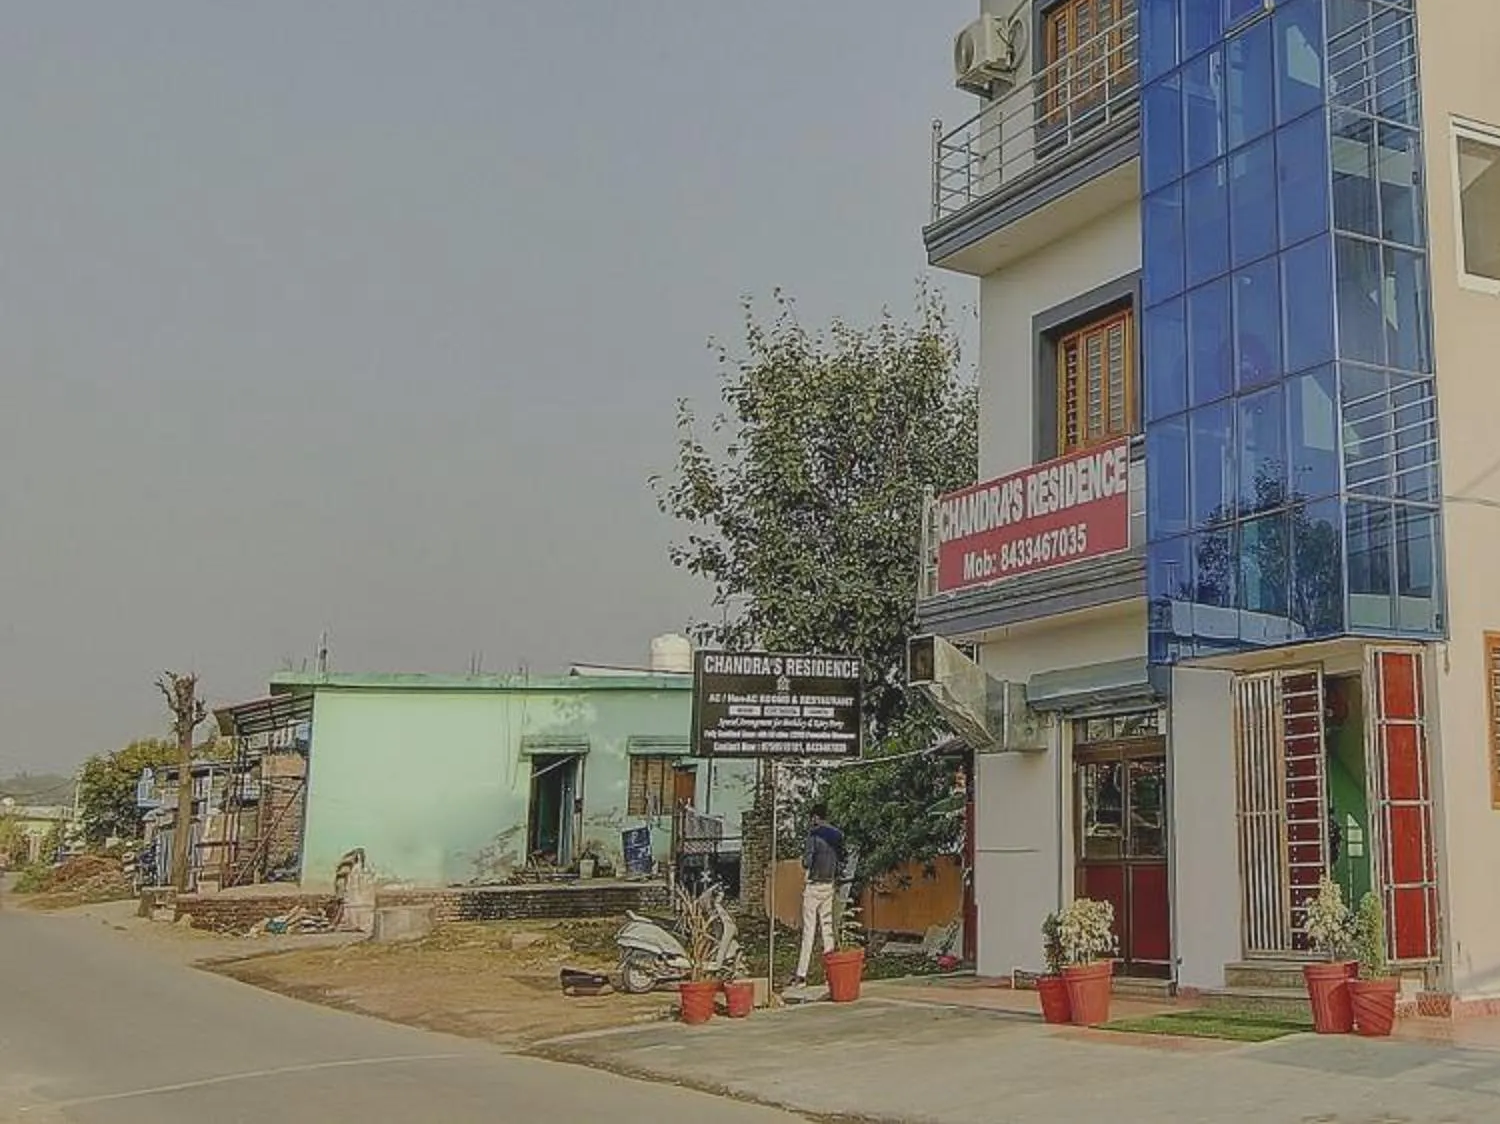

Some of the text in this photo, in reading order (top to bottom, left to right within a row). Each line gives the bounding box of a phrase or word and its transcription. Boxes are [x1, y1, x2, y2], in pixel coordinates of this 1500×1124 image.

[939, 446, 1127, 543] CHANDRA'S RESIDENCE
[963, 523, 1087, 581] Mob: 8433467035
[704, 655, 860, 678] CHANDRA'S RESIDENCE
